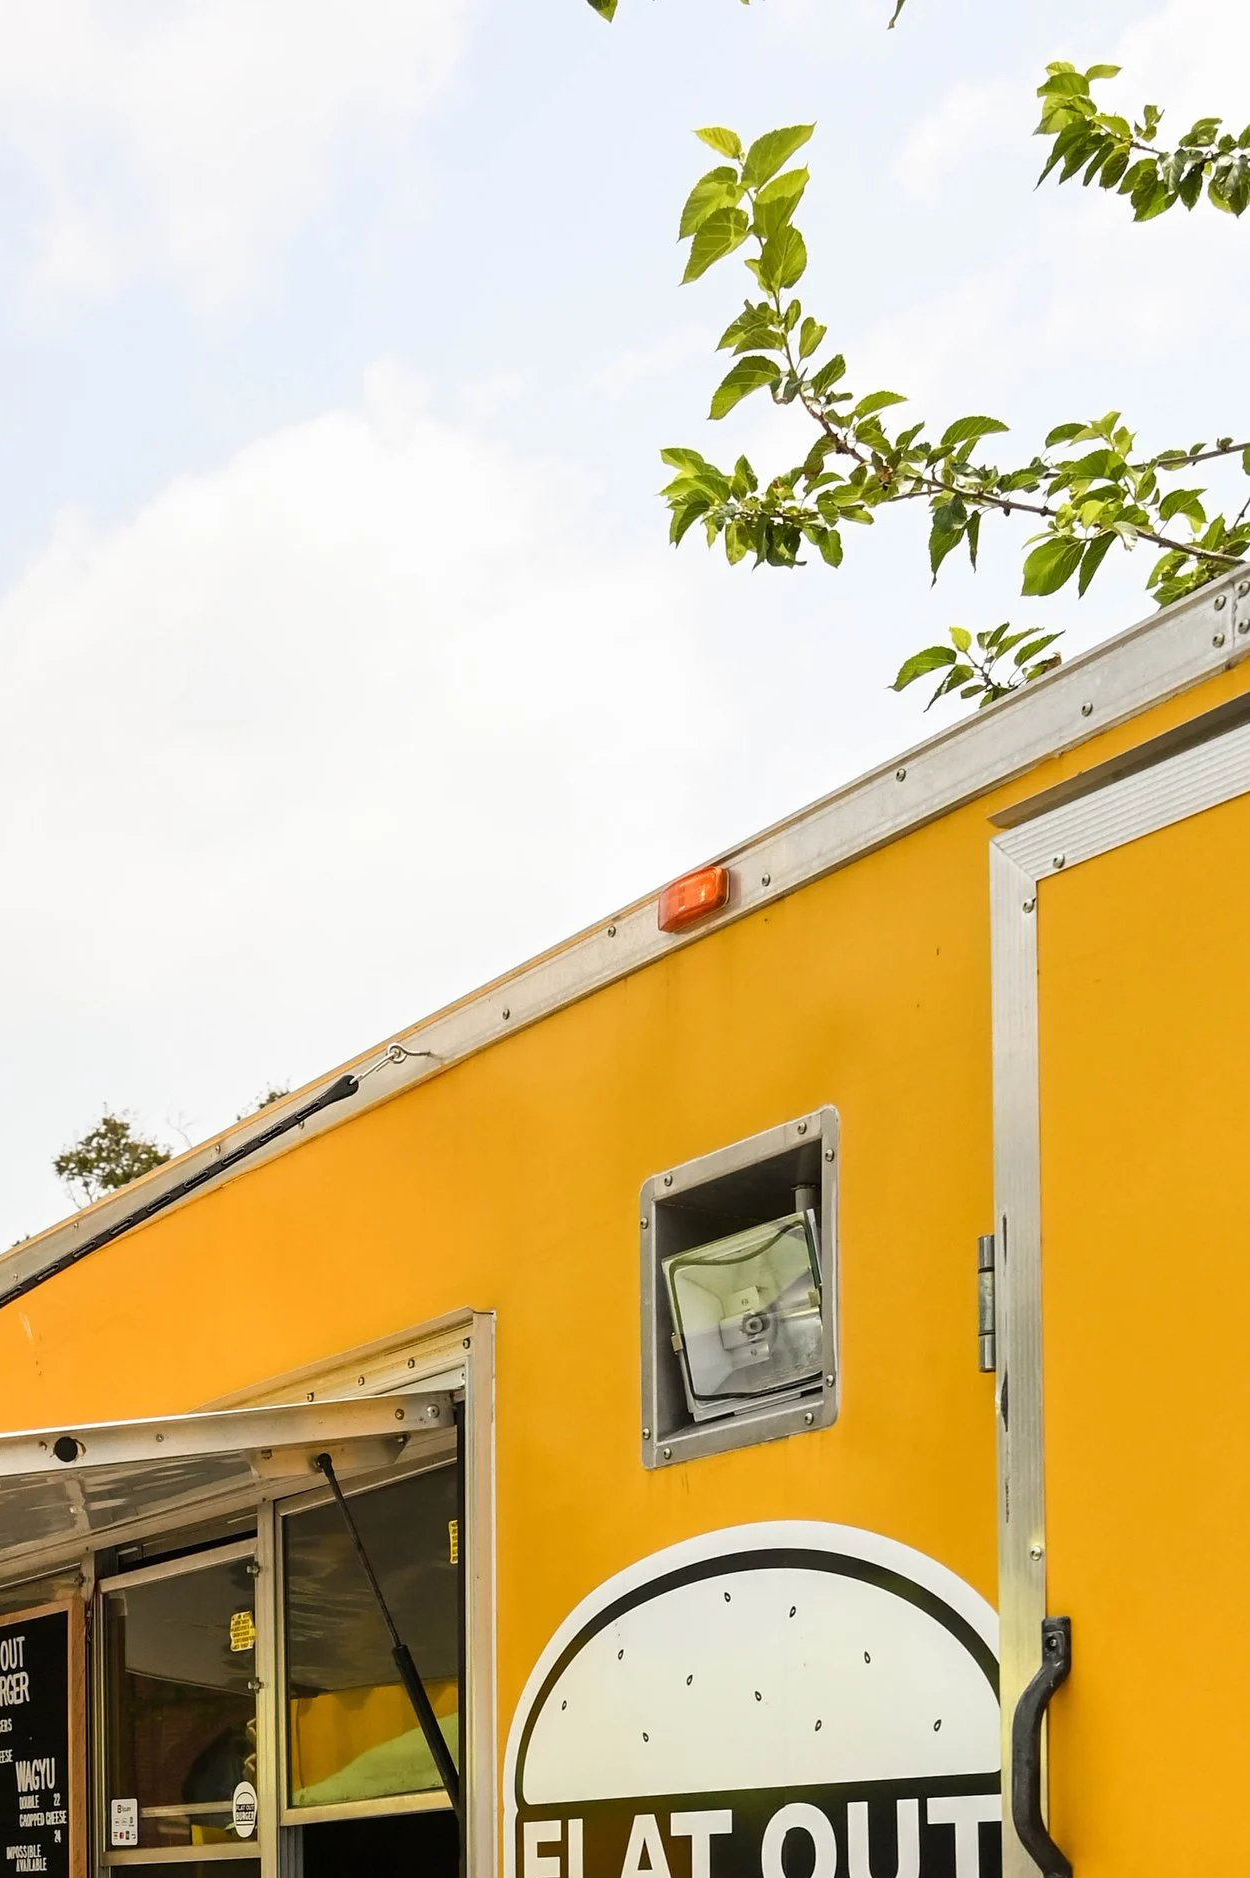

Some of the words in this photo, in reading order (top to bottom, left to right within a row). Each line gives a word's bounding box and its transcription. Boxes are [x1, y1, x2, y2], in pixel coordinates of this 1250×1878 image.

[15, 1757, 56, 1792] WAGYU
[19, 1795, 40, 1810] DOUBLE
[53, 1793, 61, 1807] 22
[45, 1810, 67, 1825] CHEESE
[6, 1844, 41, 1859] IMPOSSIBLE
[16, 1857, 47, 1872] AVAILABLE
